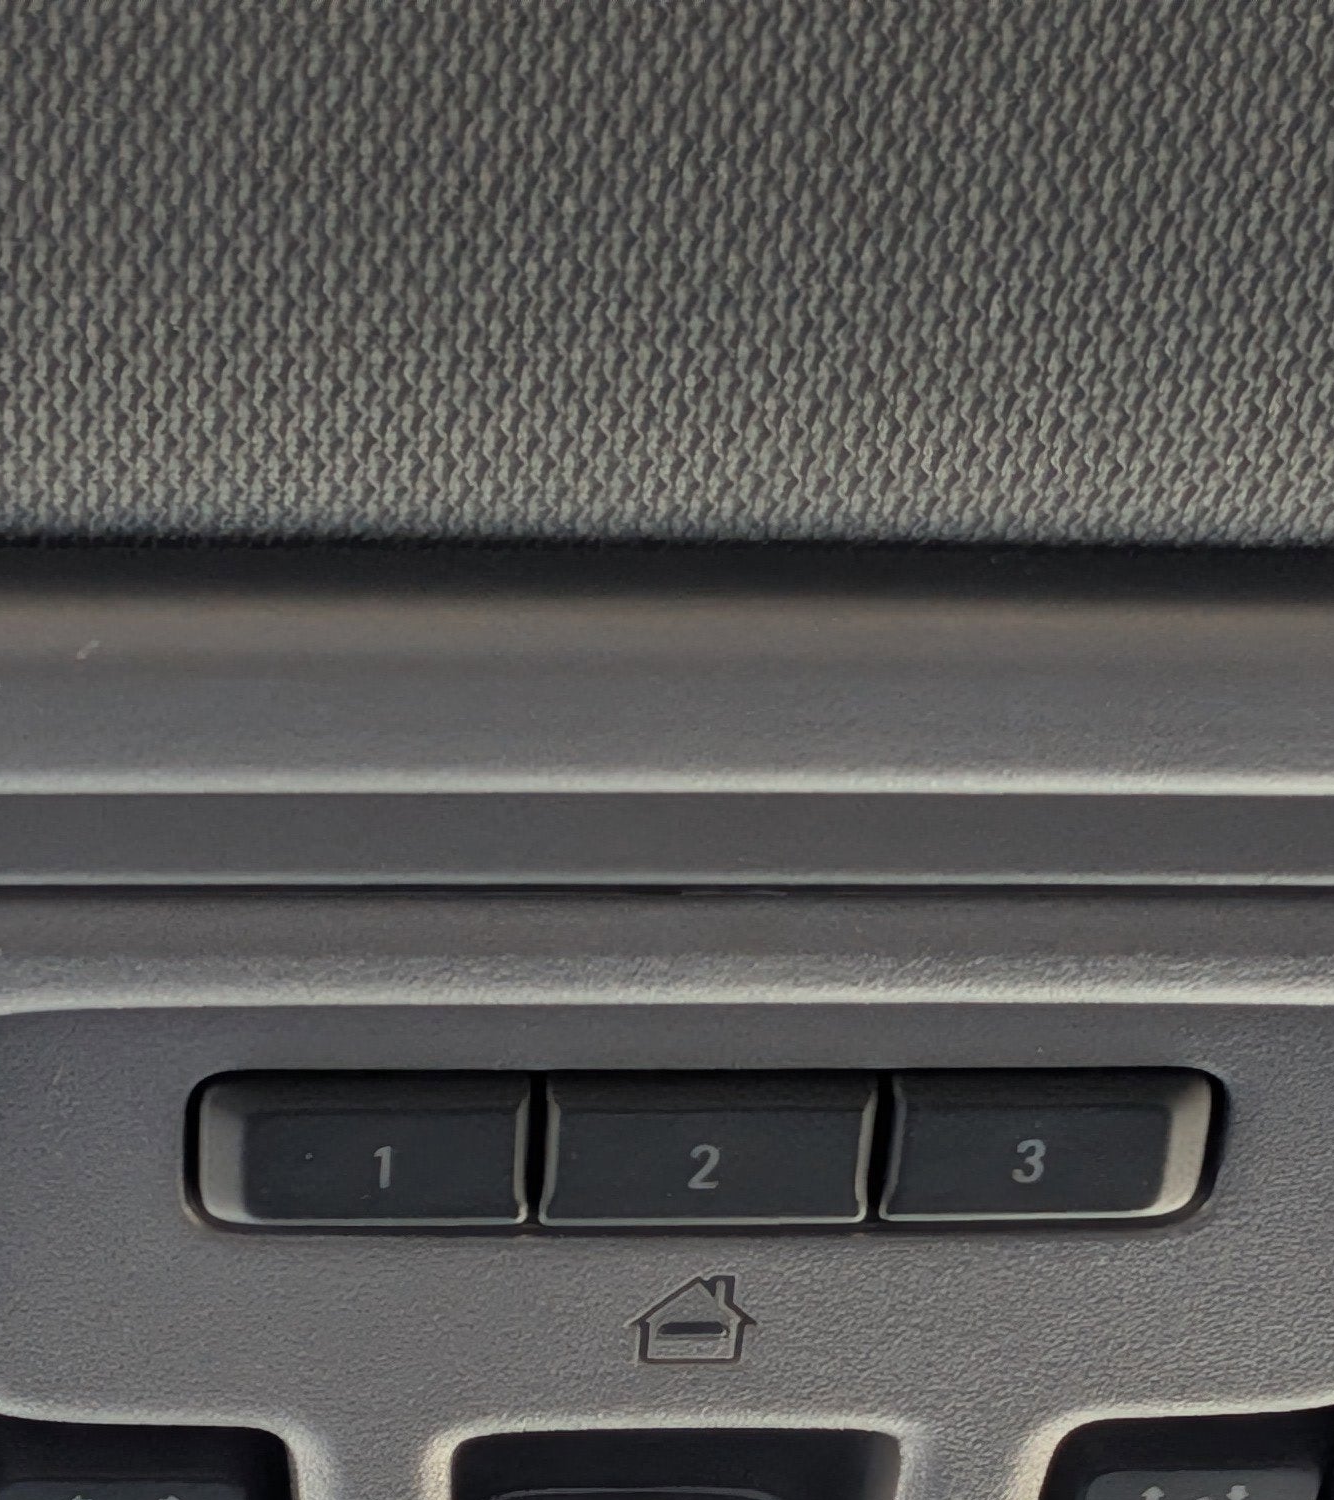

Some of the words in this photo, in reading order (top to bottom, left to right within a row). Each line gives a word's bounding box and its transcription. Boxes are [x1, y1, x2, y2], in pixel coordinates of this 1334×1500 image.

[373, 1146, 392, 1188] 1
[688, 1145, 720, 1189] 2
[1012, 1139, 1046, 1182] 3
